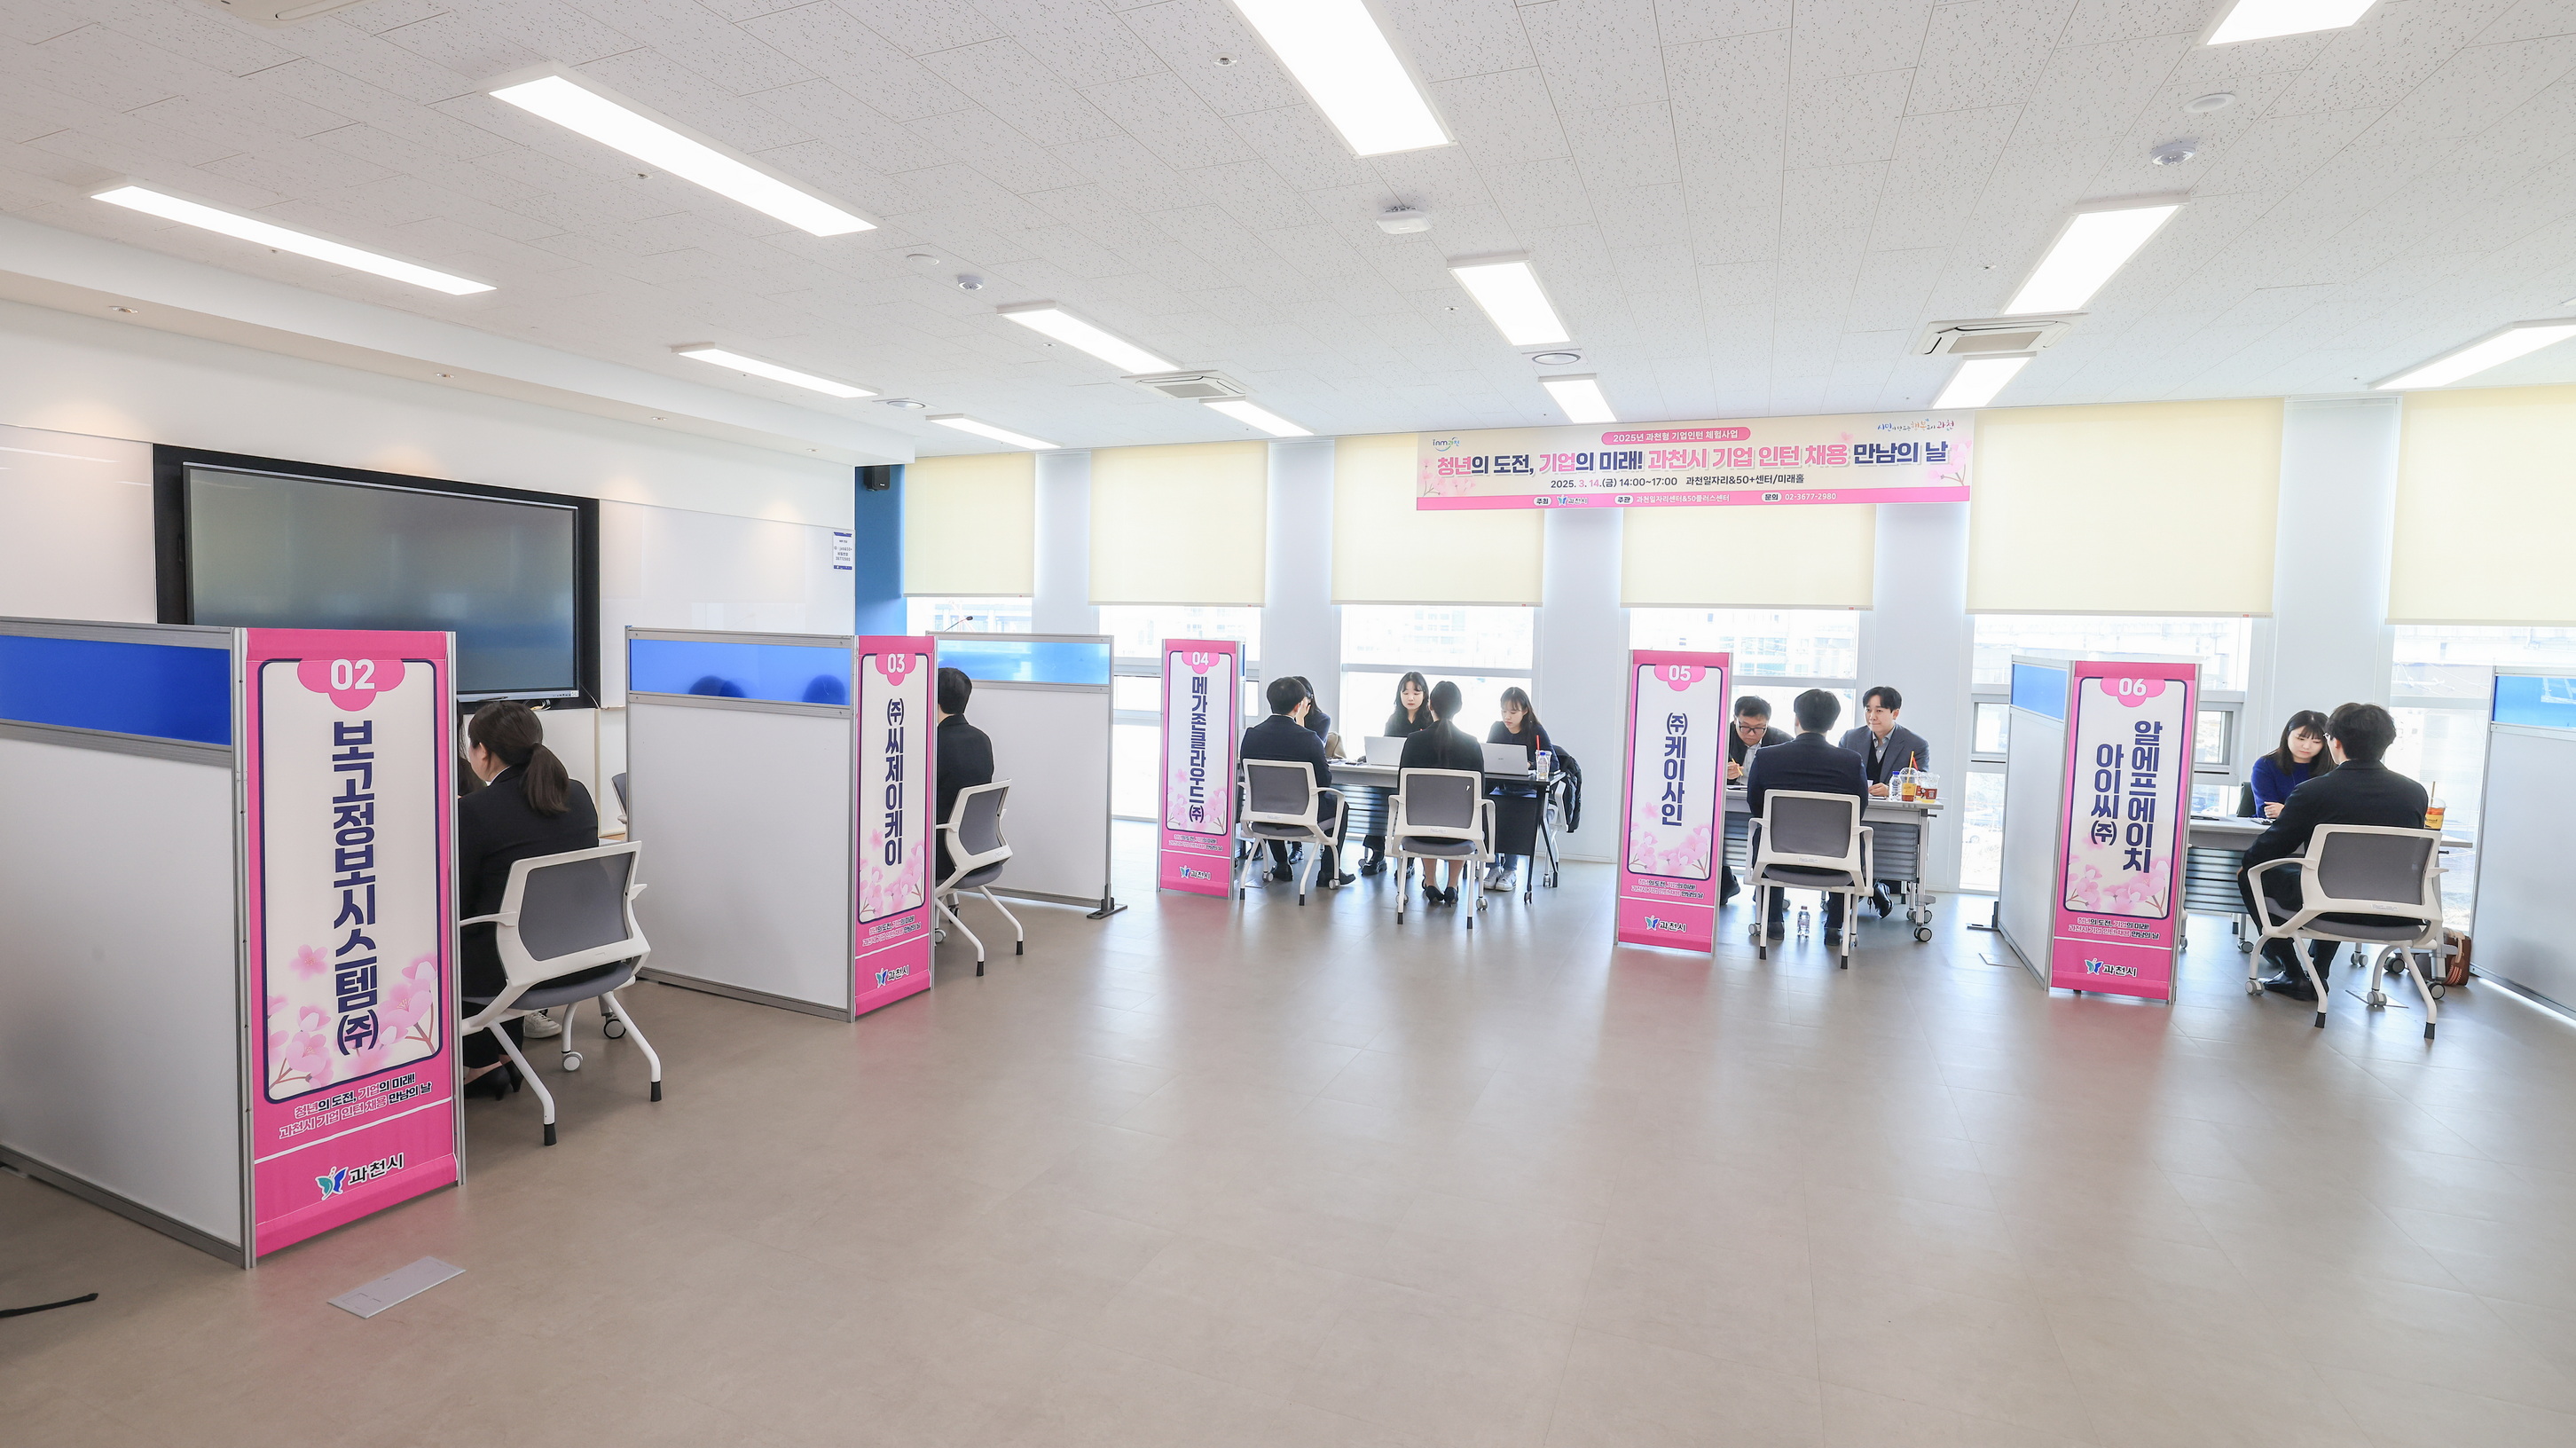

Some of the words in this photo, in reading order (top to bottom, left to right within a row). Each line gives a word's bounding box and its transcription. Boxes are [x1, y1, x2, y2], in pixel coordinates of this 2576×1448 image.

[1613, 434, 1644, 443] 2025년
[1672, 431, 1703, 440] 기업인턴
[1705, 429, 1739, 439] 체험사업
[1437, 455, 1489, 476] 청년의
[1493, 454, 1534, 475] 도전,
[1539, 452, 1594, 473] 기업의
[1599, 451, 1643, 470] 미래!
[1648, 448, 1707, 469] 과천시
[1712, 446, 1752, 468] 기업
[1759, 445, 1800, 466] 인턴
[1805, 445, 1848, 466] 채용
[1853, 442, 1919, 464] 만남의
[1925, 441, 1948, 462] 날
[1619, 477, 1677, 486] 14:00~17:00
[1685, 474, 1804, 485] 과천일자리&50+센터/미래홀
[887, 653, 906, 673] 03
[1192, 650, 1209, 666] 04
[330, 658, 375, 690] 02
[1668, 665, 1691, 681] 05
[2117, 677, 2148, 696] 06
[2123, 720, 2163, 873] 알에프에이치
[1659, 921, 1687, 933] 과천시
[2103, 964, 2138, 977] 과천시
[295, 1099, 330, 1119] 청년의
[332, 1090, 357, 1107] 도전,
[358, 1080, 390, 1100] 기업의
[392, 1072, 415, 1090] 미래!
[279, 1117, 317, 1139] 과천시
[317, 1110, 340, 1129] 기업
[341, 1102, 365, 1120] 인턴
[365, 1096, 388, 1113] 채용
[389, 1085, 419, 1105] 만남의
[420, 1082, 432, 1095] 날
[349, 1153, 404, 1184] 과천시
